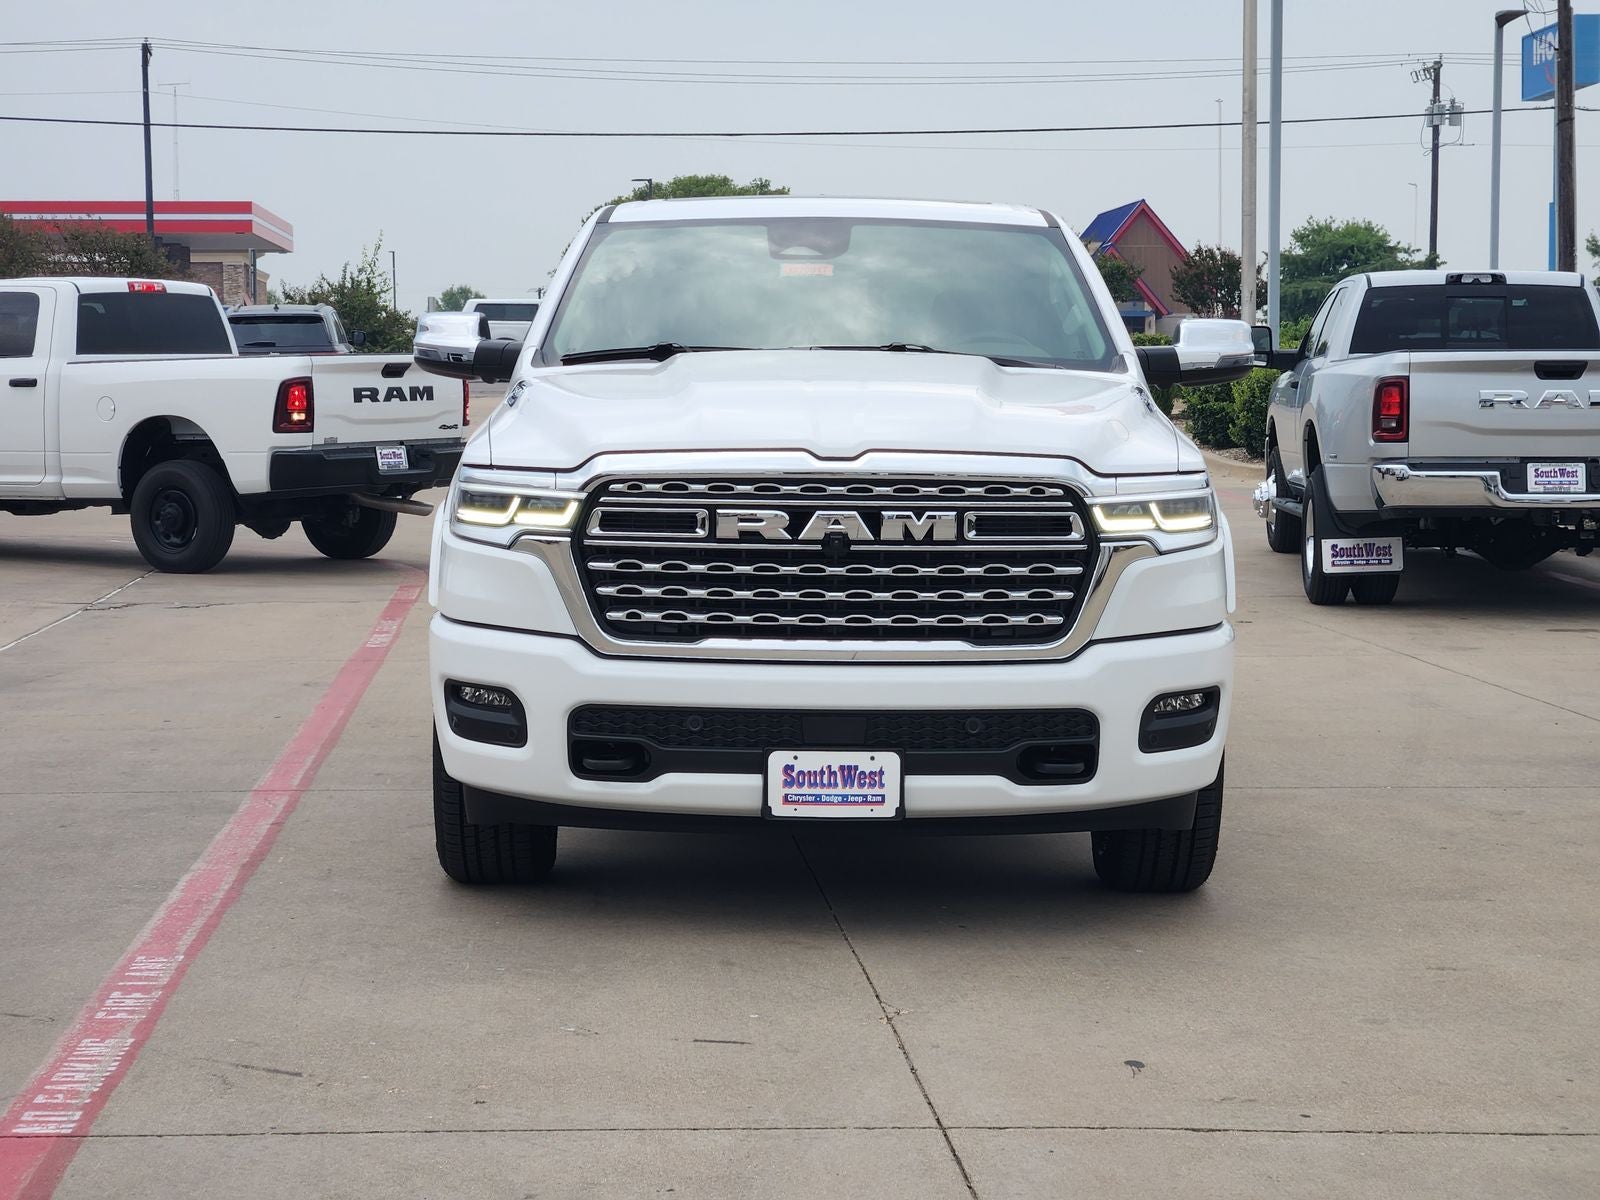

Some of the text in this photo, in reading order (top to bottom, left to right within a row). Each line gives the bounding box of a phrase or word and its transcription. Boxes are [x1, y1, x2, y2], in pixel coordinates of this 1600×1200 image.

[1533, 29, 1558, 65] IHO
[353, 386, 434, 403] RAM
[1479, 389, 1600, 409] RA
[1534, 468, 1578, 478] SouthWest
[716, 509, 957, 540] RAM
[1331, 542, 1392, 558] SouthWest
[782, 763, 885, 789] SouthWest
[788, 794, 816, 803] Chrysler
[821, 794, 842, 803] Dodge
[847, 795, 863, 803] Jeep
